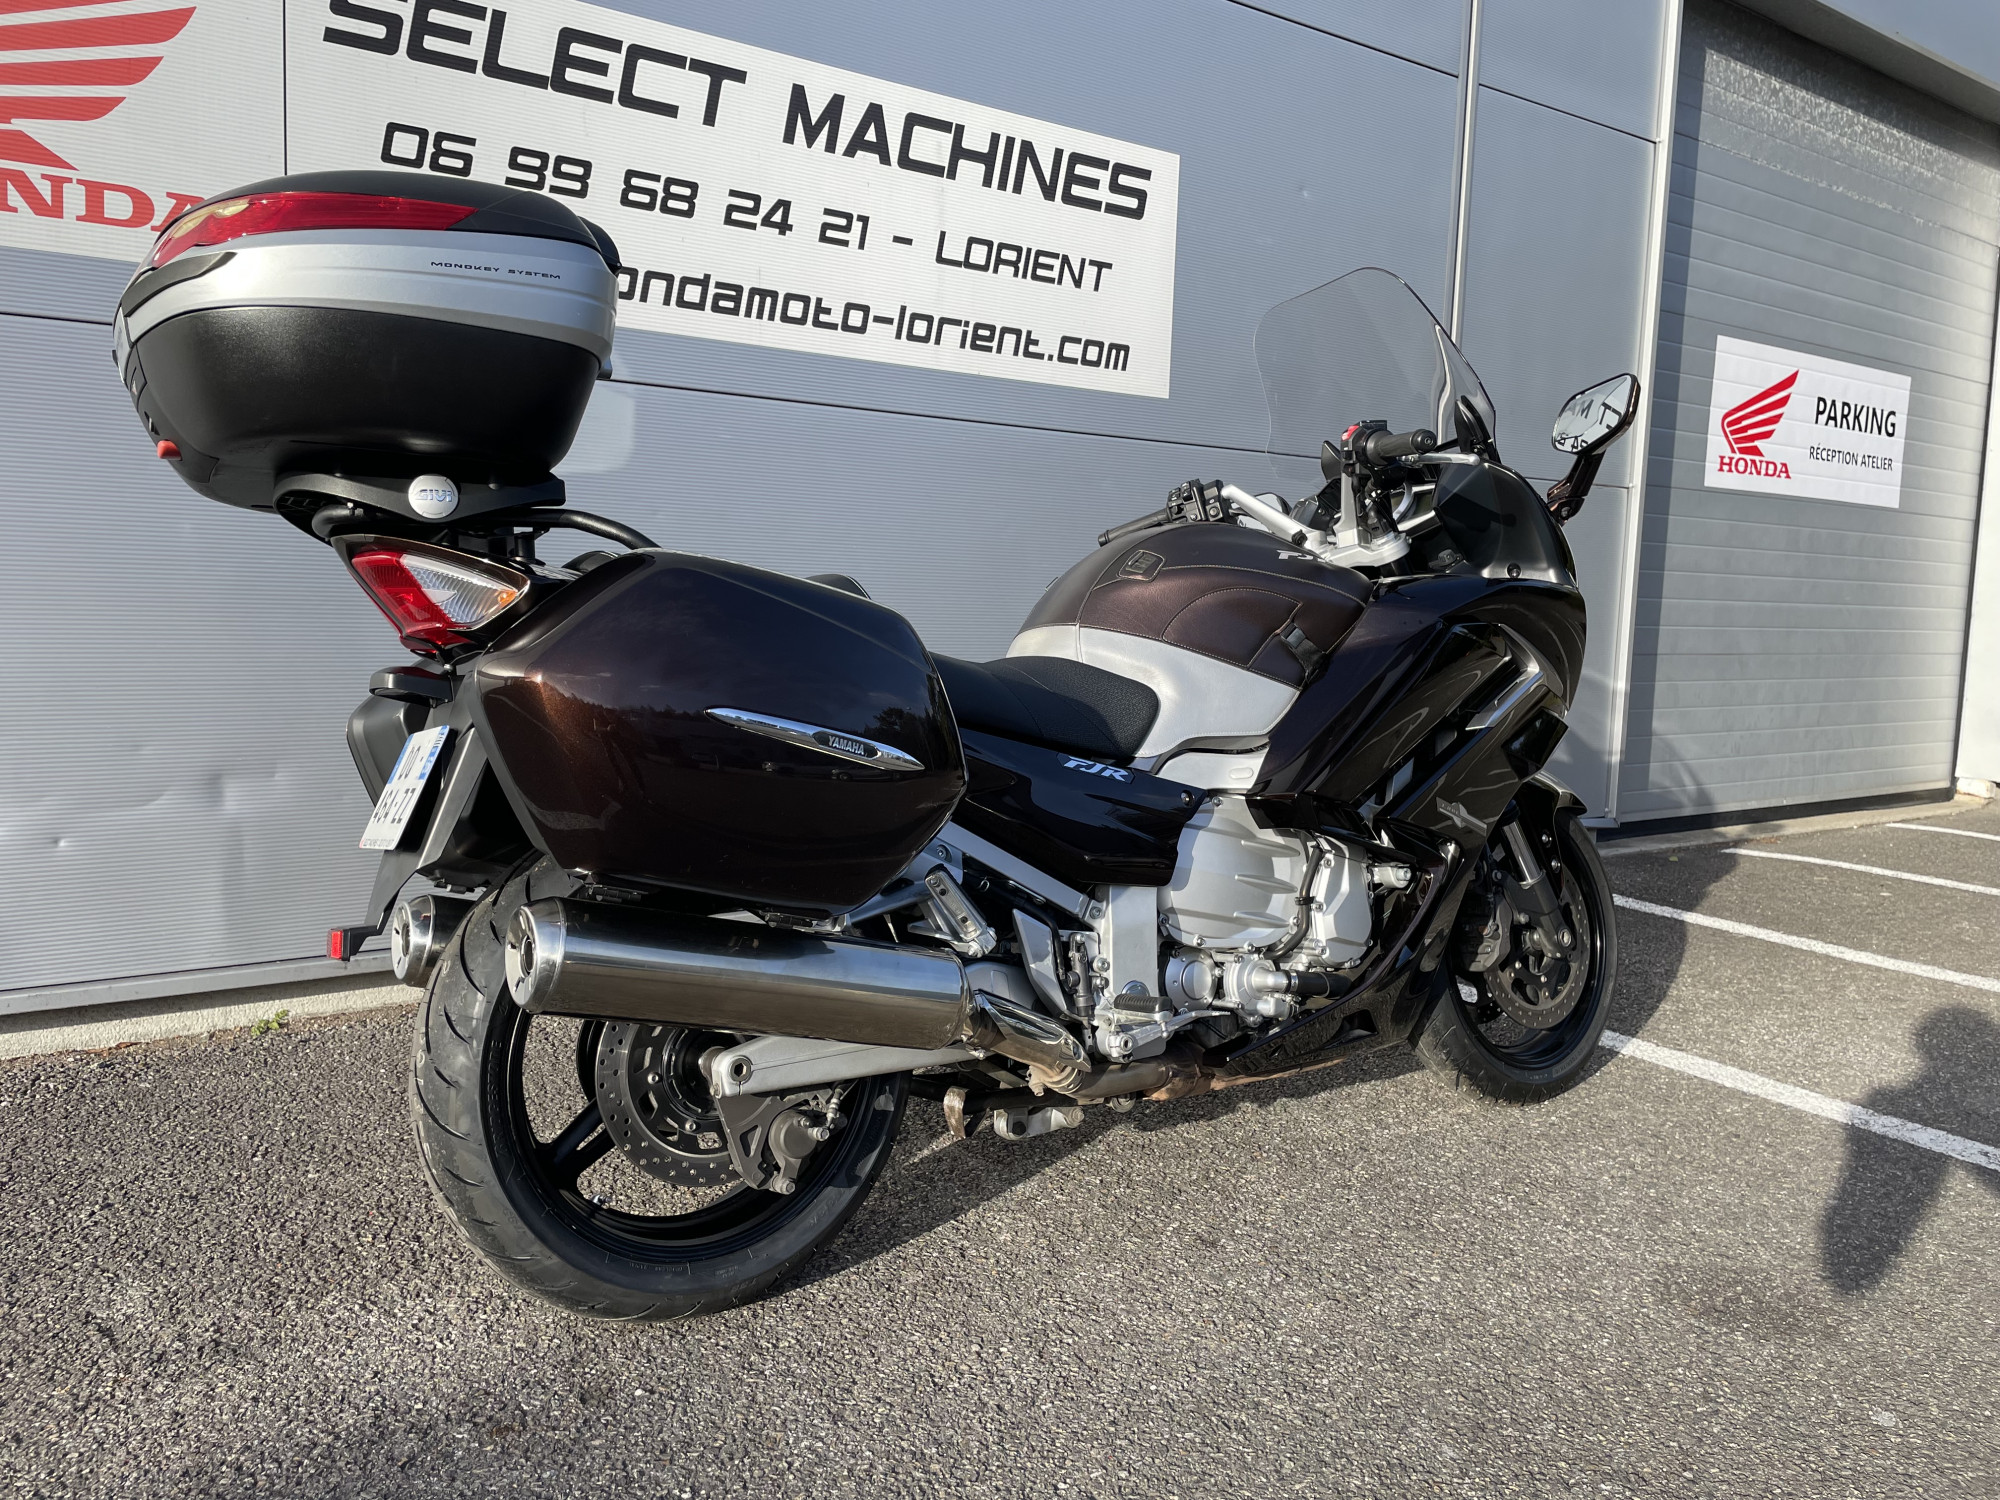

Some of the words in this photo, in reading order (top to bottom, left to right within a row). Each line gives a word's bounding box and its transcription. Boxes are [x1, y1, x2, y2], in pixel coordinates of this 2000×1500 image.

[323, 0, 747, 127] SELECT
[782, 82, 1152, 220] MACHINES
[380, 122, 477, 177] 06
[505, 146, 592, 199] 99
[620, 169, 699, 219] 68
[723, 189, 793, 236] 24
[818, 208, 870, 250] 21
[935, 231, 1112, 292] LORIENT
[431, 261, 500, 272] MONOKEY
[508, 269, 561, 280] SYSTEM
[1814, 396, 1896, 437] PARKING
[1718, 455, 1791, 479] HONDA
[1809, 442, 1858, 466] RÉCEPTION
[1860, 454, 1893, 472] ATELIER
[828, 735, 865, 756] YAMAHA
[1064, 755, 1129, 782] FJR
